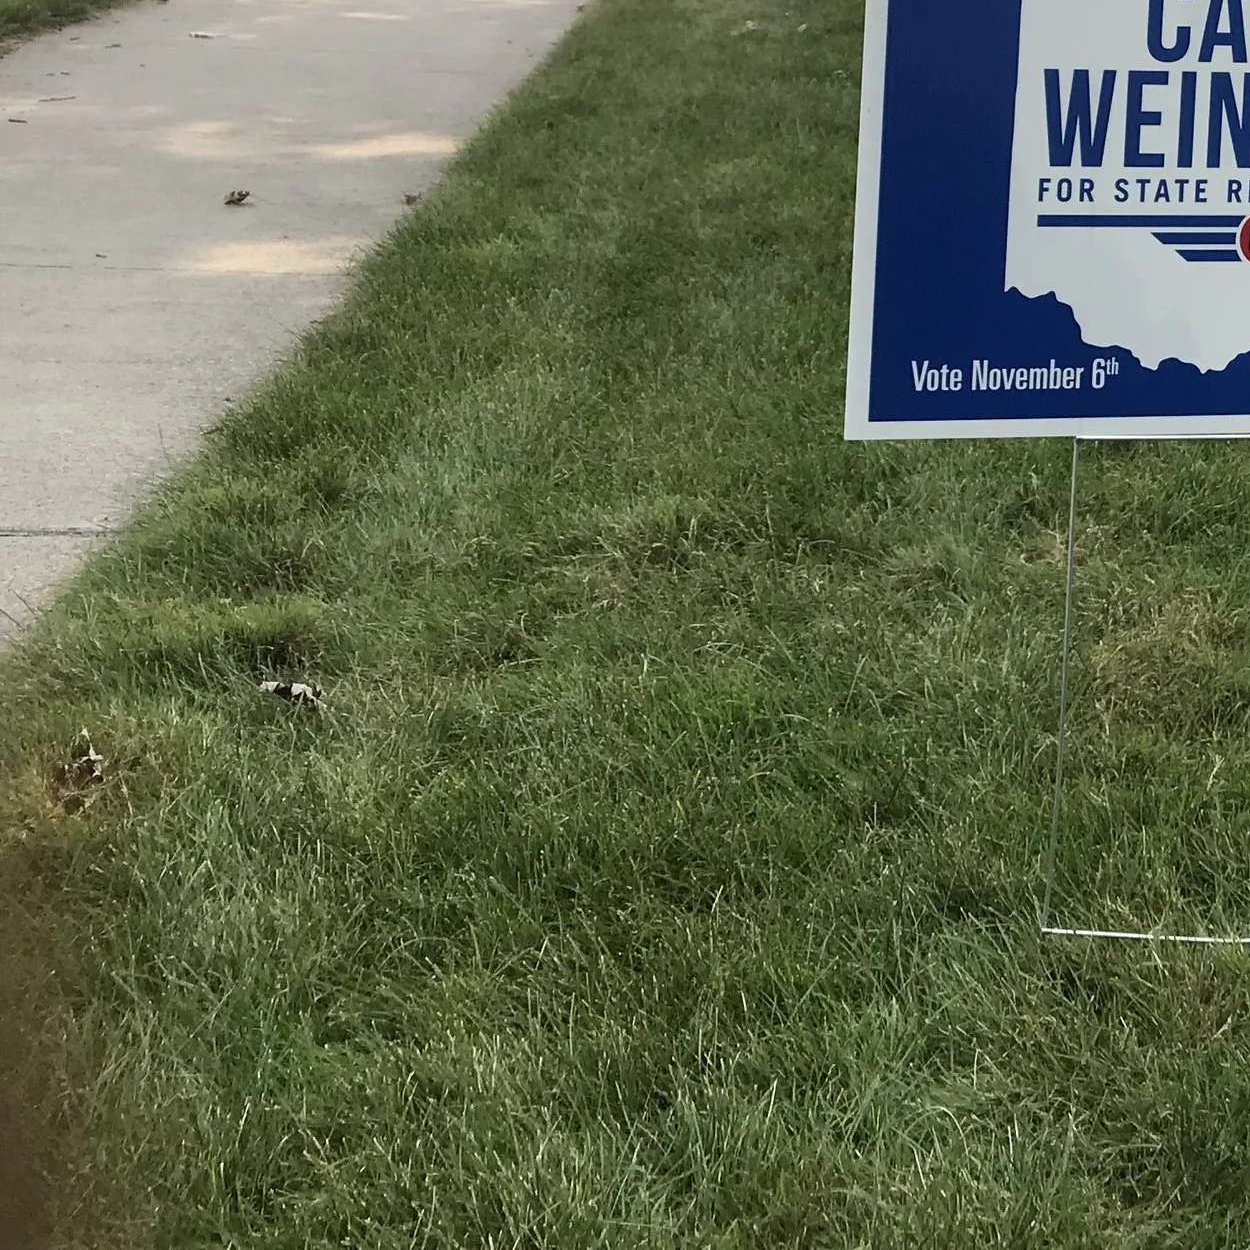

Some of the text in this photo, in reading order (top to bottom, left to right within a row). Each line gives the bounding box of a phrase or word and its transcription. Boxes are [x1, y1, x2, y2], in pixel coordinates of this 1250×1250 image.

[1037, 178, 1095, 203] FOR
[1114, 178, 1208, 204] STATE
[911, 356, 1120, 392] Vote November 6th
